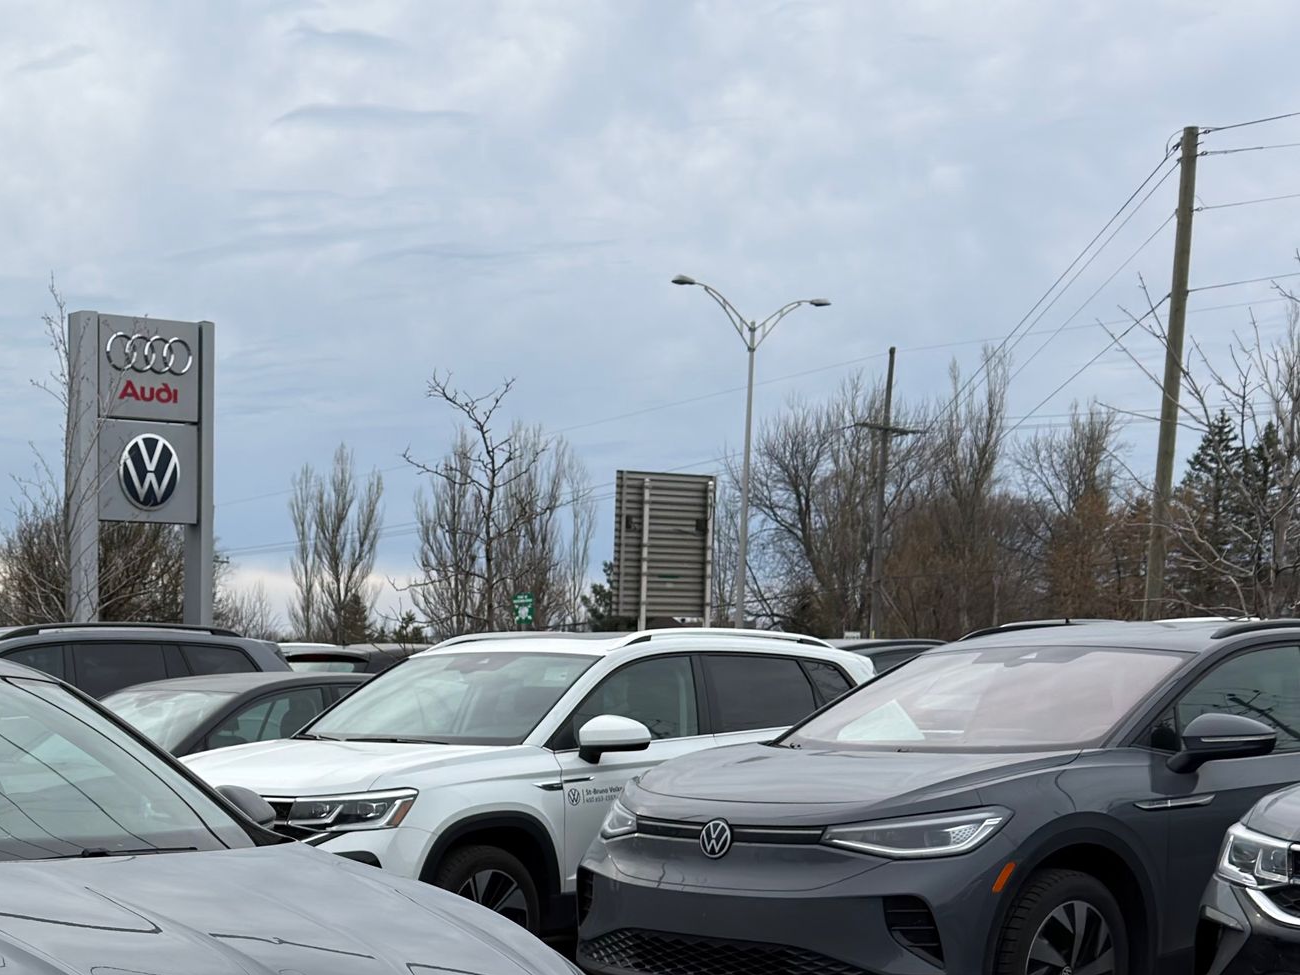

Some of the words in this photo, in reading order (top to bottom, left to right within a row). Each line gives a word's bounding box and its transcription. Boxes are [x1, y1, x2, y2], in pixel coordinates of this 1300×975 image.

[118, 379, 179, 404] Audi
[120, 434, 180, 510] VW
[700, 820, 730, 857] VW
